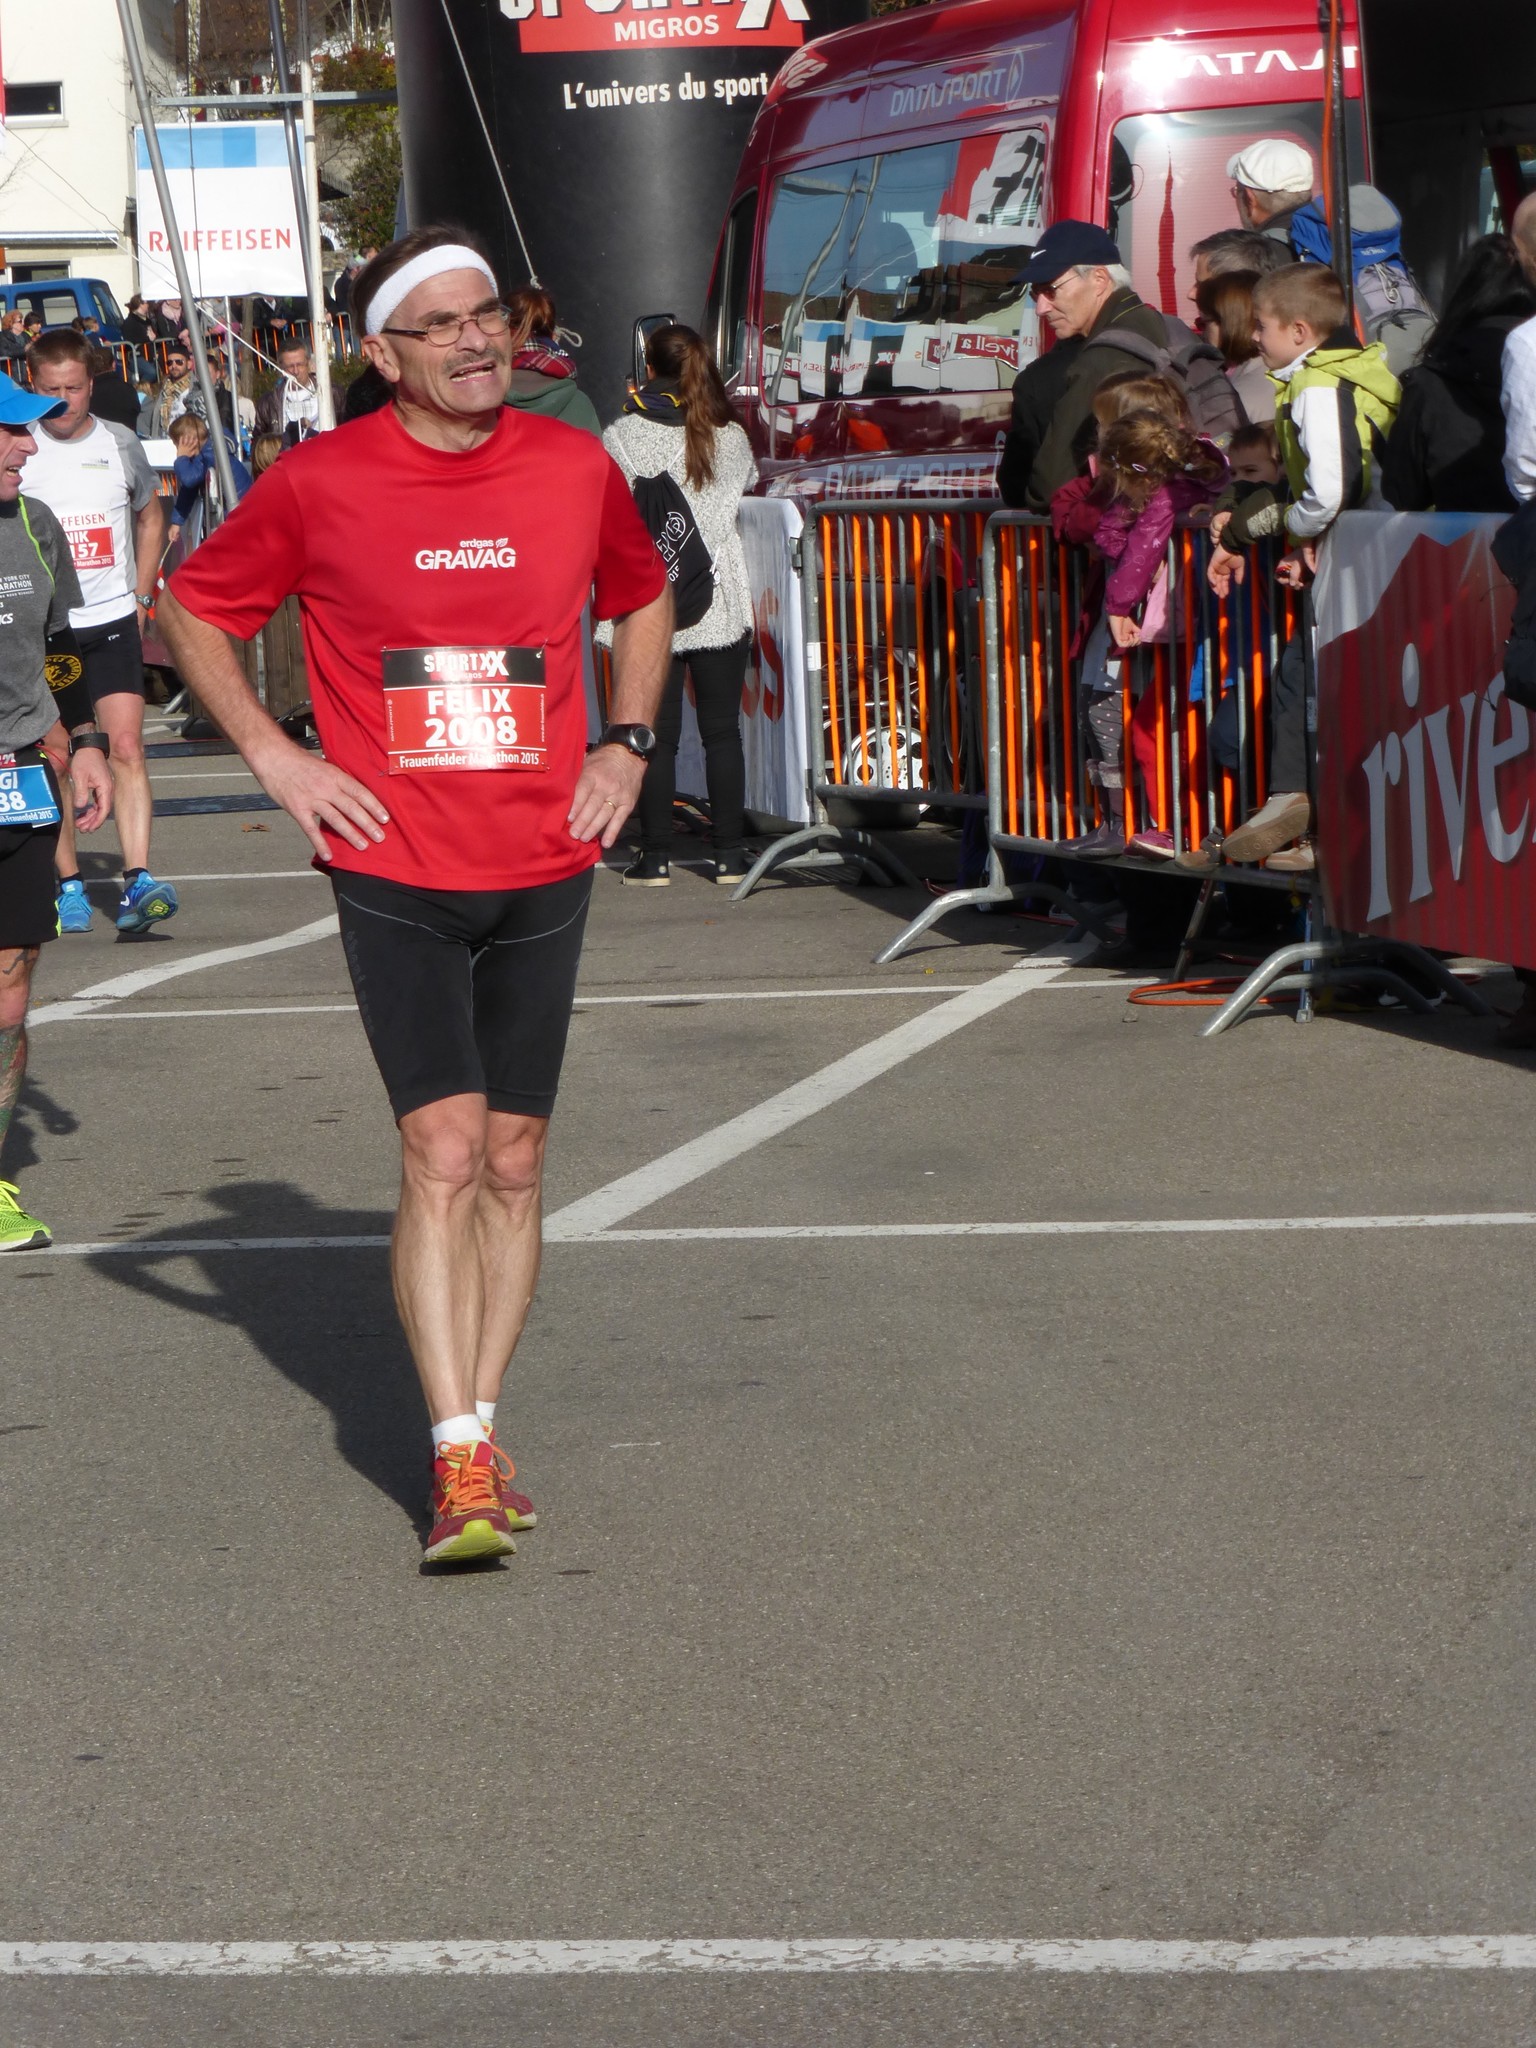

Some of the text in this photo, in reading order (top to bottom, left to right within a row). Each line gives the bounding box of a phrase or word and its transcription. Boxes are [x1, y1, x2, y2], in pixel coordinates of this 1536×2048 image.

[614, 14, 720, 42] MIGROS
[563, 72, 769, 110] L'univers du sport
[890, 68, 1007, 117] DATASPORT
[148, 228, 291, 252] RIFFEISEN
[825, 461, 988, 500] DATASPORT
[460, 539, 494, 549] erdgas
[415, 547, 516, 570] GRAVAG
[427, 688, 512, 715] FELIX
[424, 715, 518, 748] 2008
[399, 753, 467, 768] Frauenfelder
[520, 752, 540, 765] 2015
[1361, 643, 1536, 922] rive
[39, 810, 53, 819] 2015
